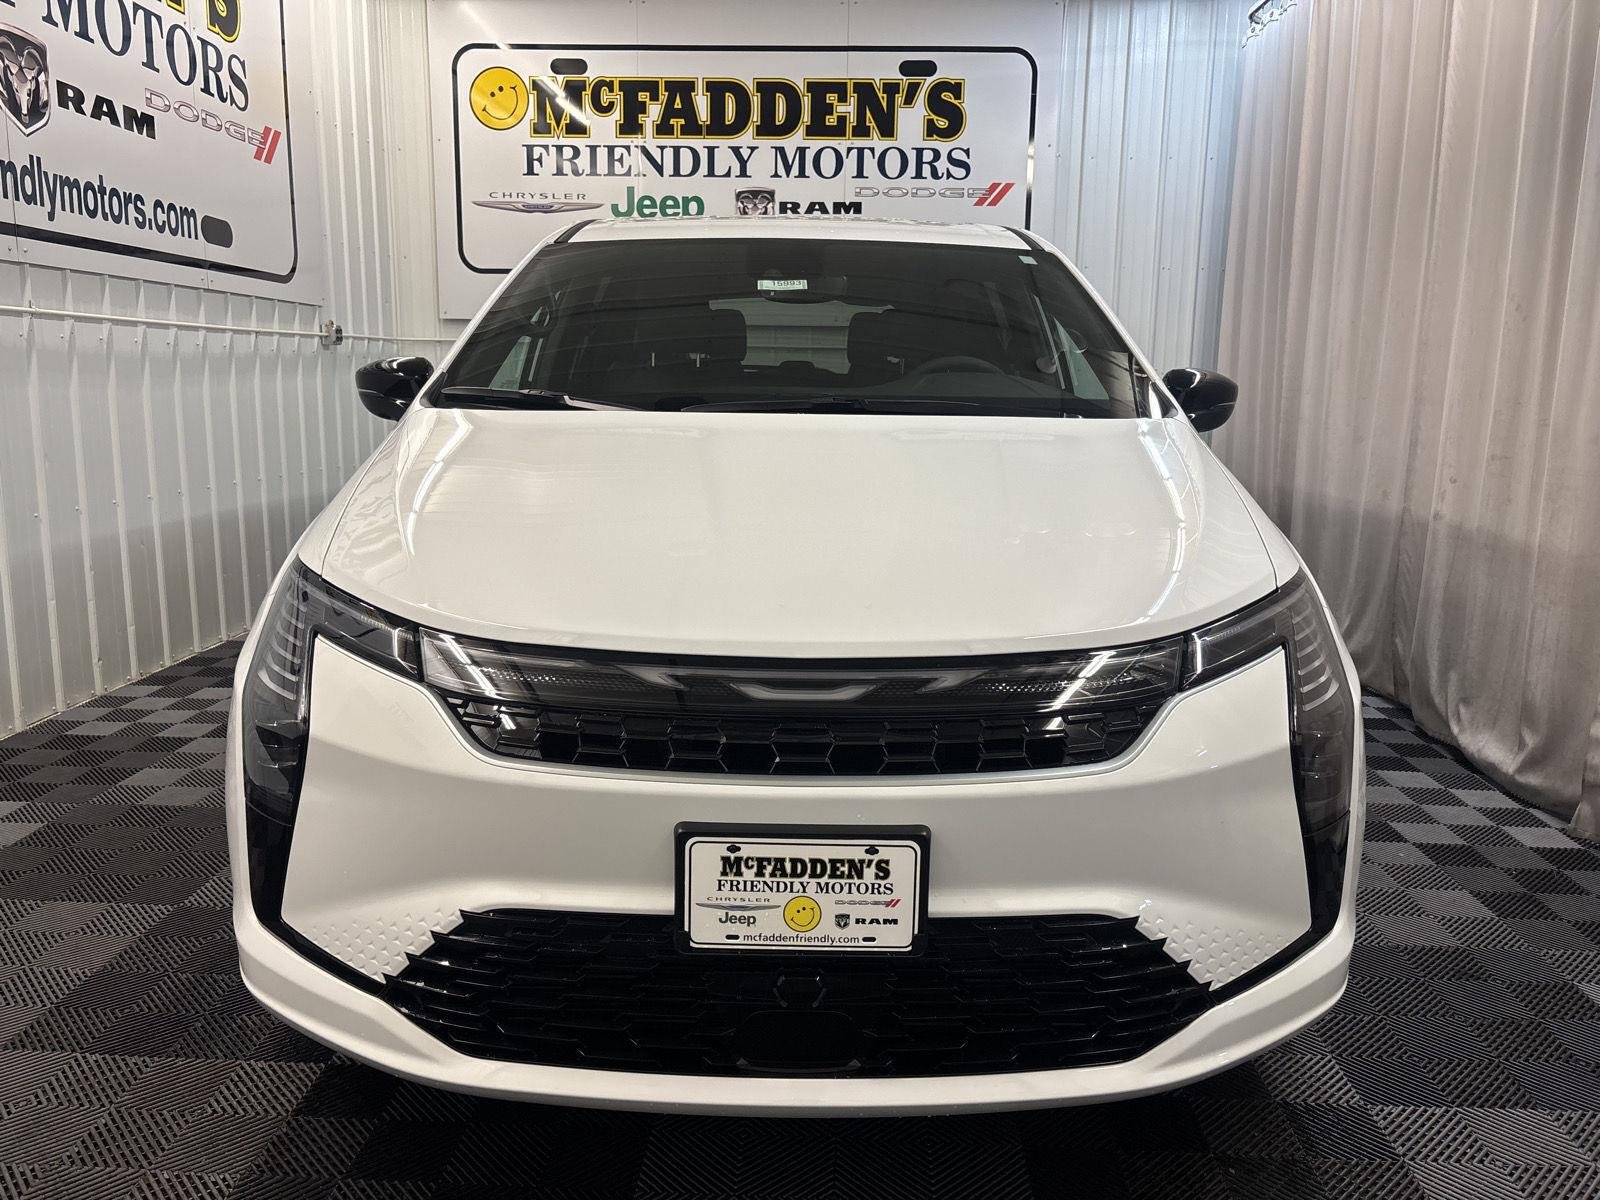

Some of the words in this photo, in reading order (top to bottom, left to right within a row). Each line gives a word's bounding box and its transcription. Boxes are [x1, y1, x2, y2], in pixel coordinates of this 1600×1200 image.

[56, 80, 156, 140] RAM
[145, 88, 267, 150] DODGE
[522, 144, 761, 178] FRIENDLY
[770, 145, 972, 181] MOTORS
[0, 154, 199, 241] ndlymotors.com
[489, 191, 587, 200] CHRYSLER
[855, 186, 989, 198] DODGE
[610, 185, 706, 218] Jeep
[778, 201, 863, 215] RAM
[716, 879, 811, 895] FRIENDLY
[815, 881, 894, 896] MOTORS
[718, 911, 757, 926] Jeep
[854, 917, 899, 925] RAM
[743, 933, 860, 945] mcfaddenfriendly.com
